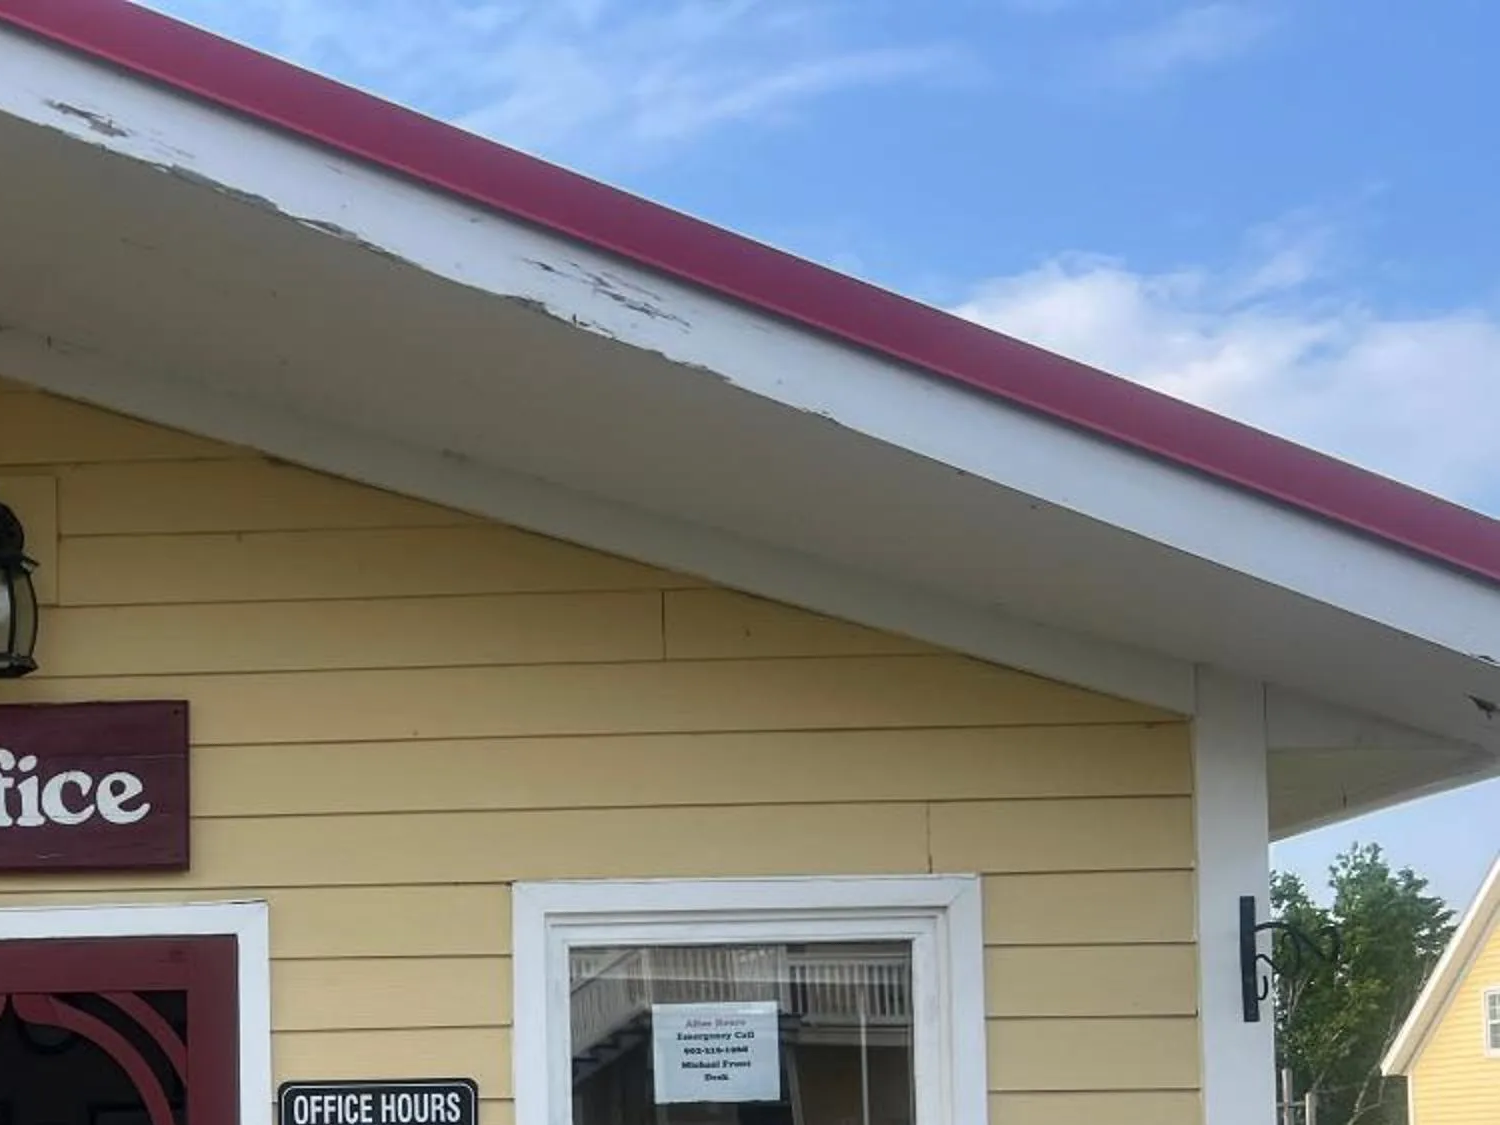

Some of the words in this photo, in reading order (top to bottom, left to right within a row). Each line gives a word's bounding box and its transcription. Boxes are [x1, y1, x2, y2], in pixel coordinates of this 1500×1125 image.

[677, 1032, 732, 1041] Emergency
[734, 1031, 755, 1039] Call
[704, 1073, 729, 1081] Desk
[293, 1094, 373, 1124] OFFICE
[381, 1092, 461, 1123] HOURS
